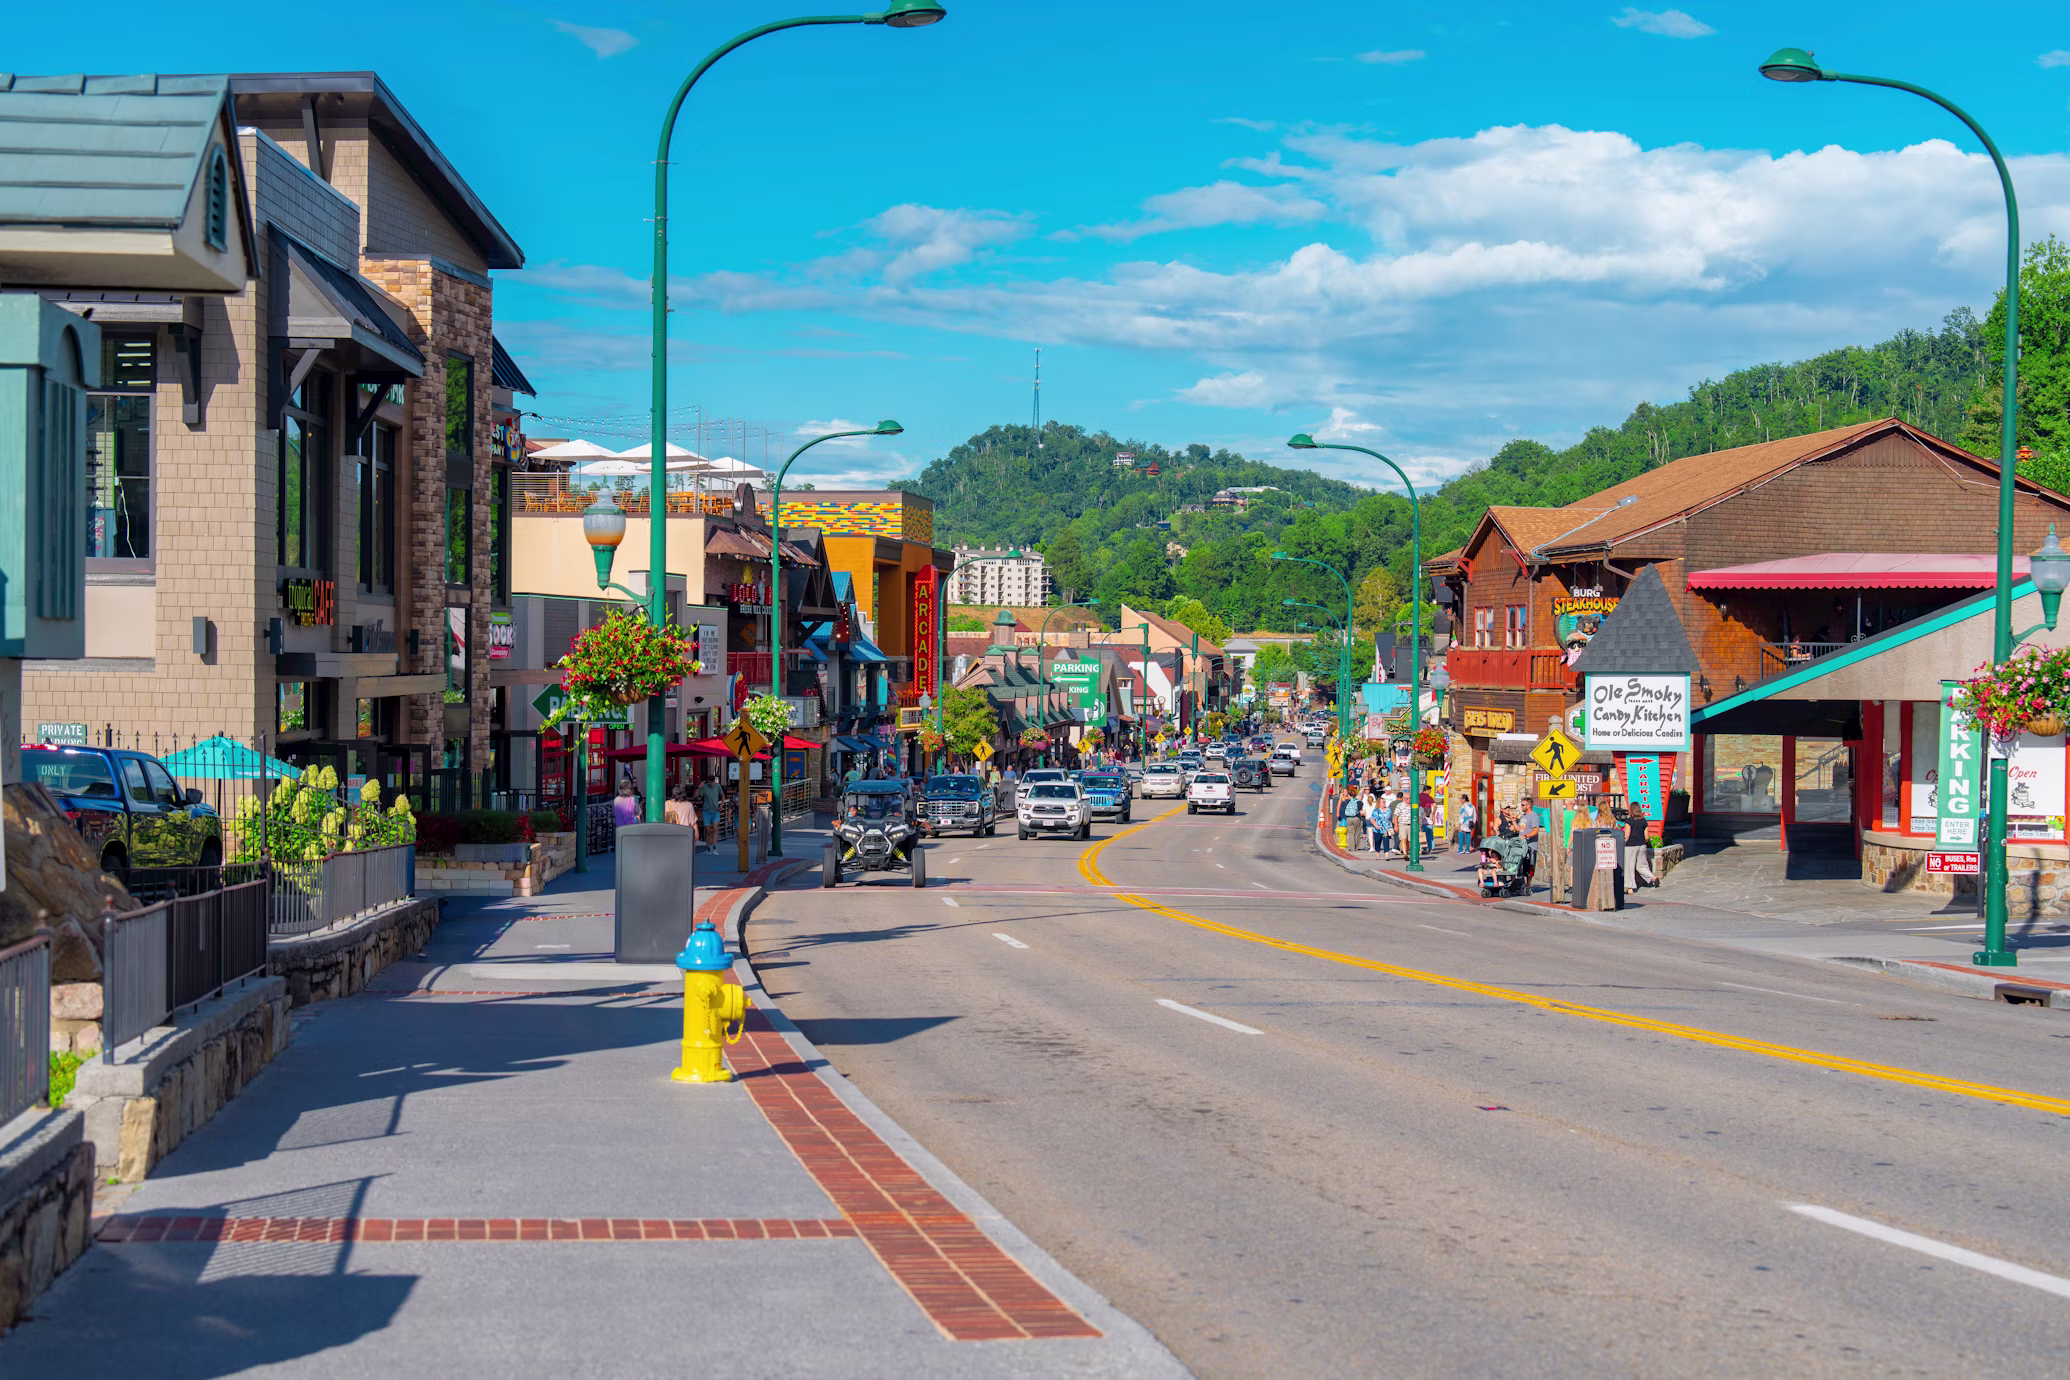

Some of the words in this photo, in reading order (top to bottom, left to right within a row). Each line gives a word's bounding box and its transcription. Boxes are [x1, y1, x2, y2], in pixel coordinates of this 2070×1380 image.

[1573, 589, 1600, 597] BURG
[314, 579, 334, 626] CAFE
[1554, 597, 1620, 615] STEAKHOUSE
[918, 585, 929, 689] ARCADE
[1054, 664, 1099, 672] PARKING
[1594, 684, 1623, 704] Ole
[1624, 678, 1682, 709] Smoky
[1593, 707, 1631, 728] Candy
[1630, 704, 1682, 728] Kitchen
[41, 724, 82, 735] PRIVATE
[1592, 728, 1611, 736] Home
[1621, 728, 1653, 737] Delicious
[1655, 729, 1683, 737] Candies
[1947, 688, 1971, 814] PARKING
[41, 765, 66, 776] ONLY
[1925, 769, 1938, 783] Op
[2008, 765, 2038, 780] Open
[1535, 774, 1550, 782] FIR
[1563, 774, 1600, 784] UNITED
[1639, 766, 1652, 816] PARKING
[1929, 857, 1942, 868] NO
[1945, 855, 1966, 863] BUSES,
